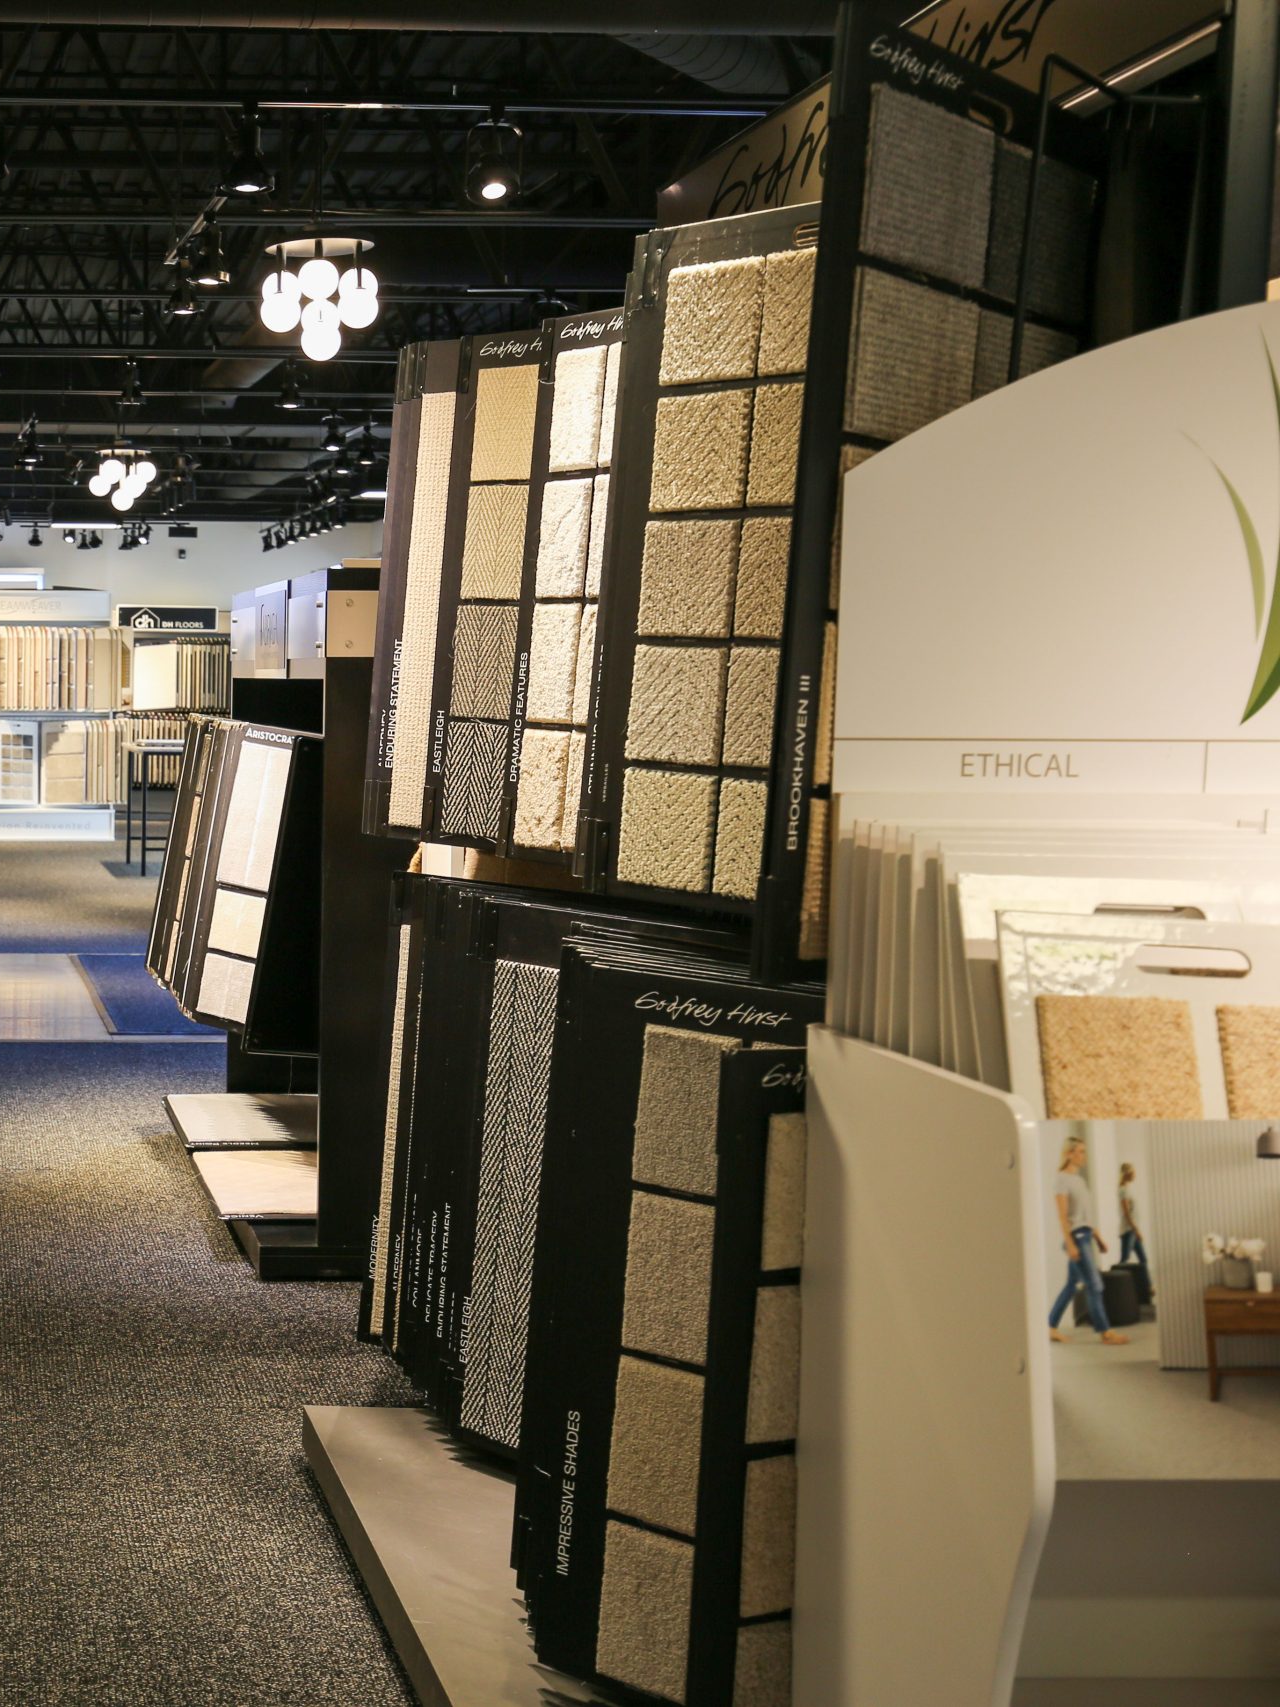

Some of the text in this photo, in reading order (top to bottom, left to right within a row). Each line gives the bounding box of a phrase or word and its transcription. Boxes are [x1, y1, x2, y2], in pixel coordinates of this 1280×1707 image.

[479, 340, 529, 358] Godfrey
[560, 321, 606, 341] Godfrey
[175, 621, 204, 629] FLOORS
[384, 639, 403, 768] ENDURING STATEMENT
[509, 652, 528, 782] DRAMATIC FEATURES
[245, 727, 295, 744] ARISTOCRA
[432, 710, 445, 773] EASTLEIGH
[960, 753, 1079, 778] ETHICAL
[786, 699, 809, 850] BROOKHAVEN
[634, 991, 793, 1028] Godfrey Hirst
[368, 1215, 380, 1280] MODERNITY
[458, 1296, 472, 1364] EASTLEIGH
[556, 1410, 581, 1576] IMPRESSIVE SHADES
